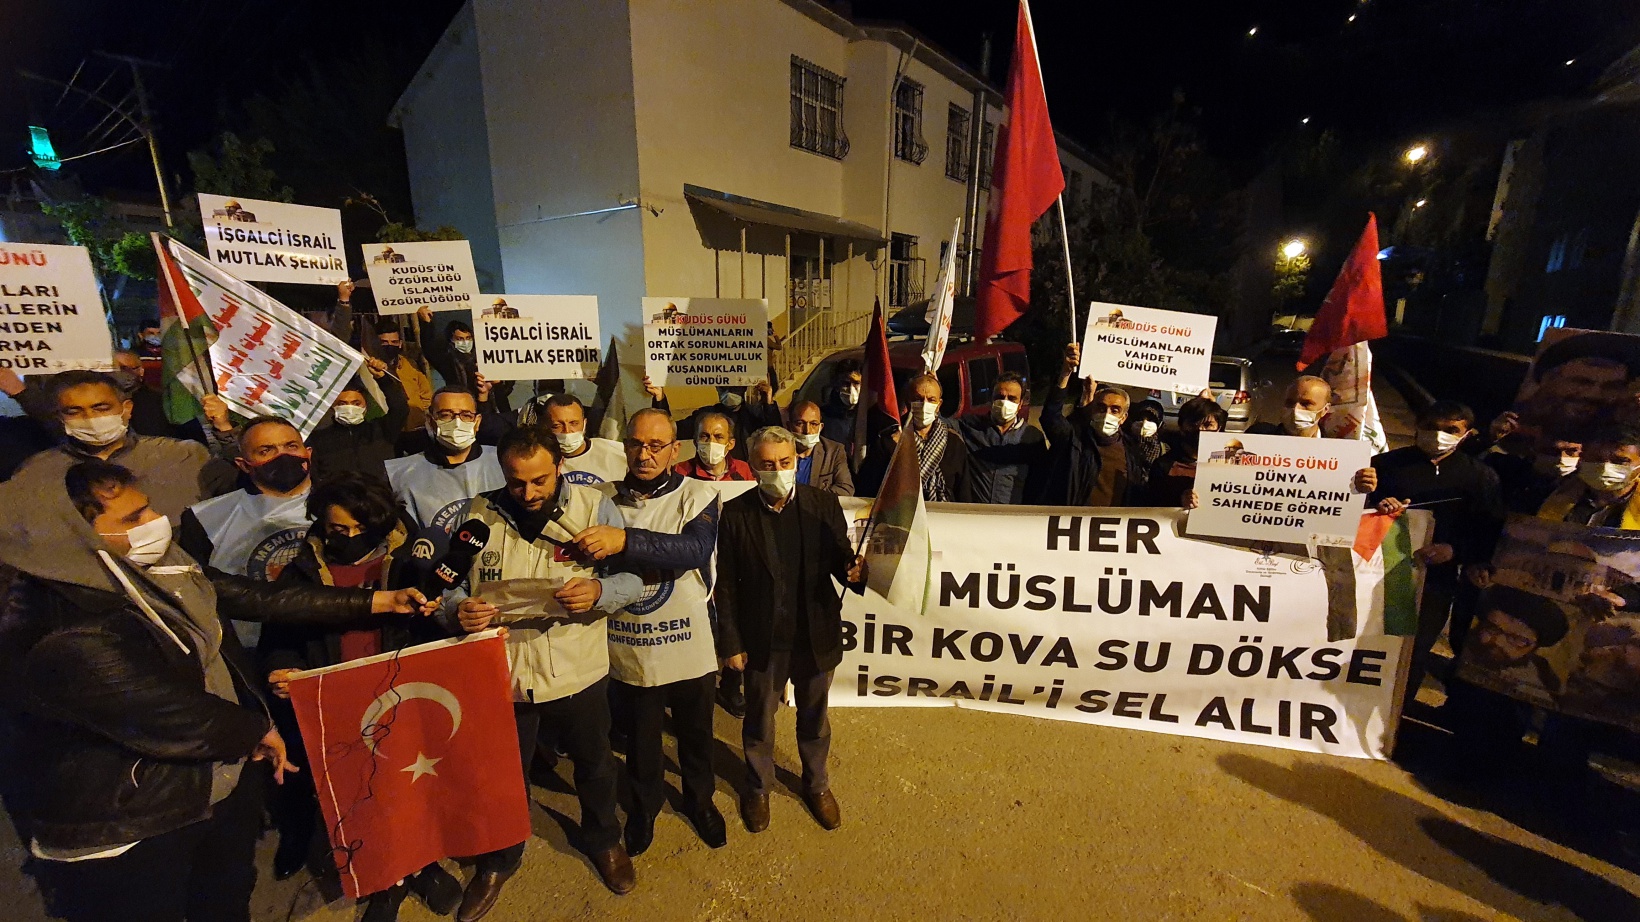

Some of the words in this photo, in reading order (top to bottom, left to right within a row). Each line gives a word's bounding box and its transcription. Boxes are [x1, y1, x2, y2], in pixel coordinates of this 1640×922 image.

[217, 223, 284, 245] İŞGALCİ
[286, 230, 336, 250] İSRAİL
[217, 250, 287, 267] MUTLAK
[290, 254, 344, 270] ŞERDİR
[392, 264, 454, 274] KUDÜS'ÜN
[389, 273, 461, 285] ÖZGÜRLÜĞÜ
[402, 286, 453, 294] İSLAMIN
[381, 293, 470, 306] ÖZGÜRLÜĞÜDÜ
[0, 301, 78, 315] LERİN
[677, 313, 714, 324] KUDÜS
[716, 313, 747, 324] GÜNÜ
[484, 322, 543, 342] İŞGALCİ
[546, 322, 592, 340] İSRAİL
[658, 326, 754, 336] MÜSLÜMANLARIN
[1120, 321, 1157, 333] KUDÜS
[1161, 325, 1192, 338] GÜNÜ
[648, 340, 685, 349] ORTAK
[687, 340, 764, 349] SORUNLARINA
[1097, 334, 1205, 356] MÜSLÜMANLARIN
[483, 350, 545, 364] MUTLAK
[547, 345, 599, 365] ŞERDİR
[650, 353, 687, 361] ORTAK
[690, 353, 763, 361] SORUMLULUK
[1125, 349, 1174, 363] VAHDET
[667, 365, 747, 374] KUŞANDIKLARI
[1117, 360, 1178, 376] GÜNÜDÜR
[686, 375, 730, 385] GÜNDÜR
[1241, 454, 1292, 468] KUDÜS
[1296, 456, 1339, 471] GÜNÜ
[1255, 470, 1308, 484] DÜNYA
[1210, 481, 1350, 502] MÜSLÜMANLARINI
[1212, 498, 1283, 512] SAHNEDE
[1288, 500, 1342, 516] GÖRME
[1242, 513, 1305, 528] GÜNDÜR
[1047, 516, 1161, 554] HER
[440, 563, 459, 578] TRT
[939, 562, 1271, 623] MÜSLÜMAN
[840, 613, 913, 656] BİR
[931, 627, 1079, 669] KOVA
[1094, 639, 1171, 674] SU
[1186, 636, 1387, 686] DÖKSE
[857, 665, 1065, 709] İSRAİL'İ
[1074, 690, 1179, 723] SEL
[1195, 696, 1340, 744] ALIR
